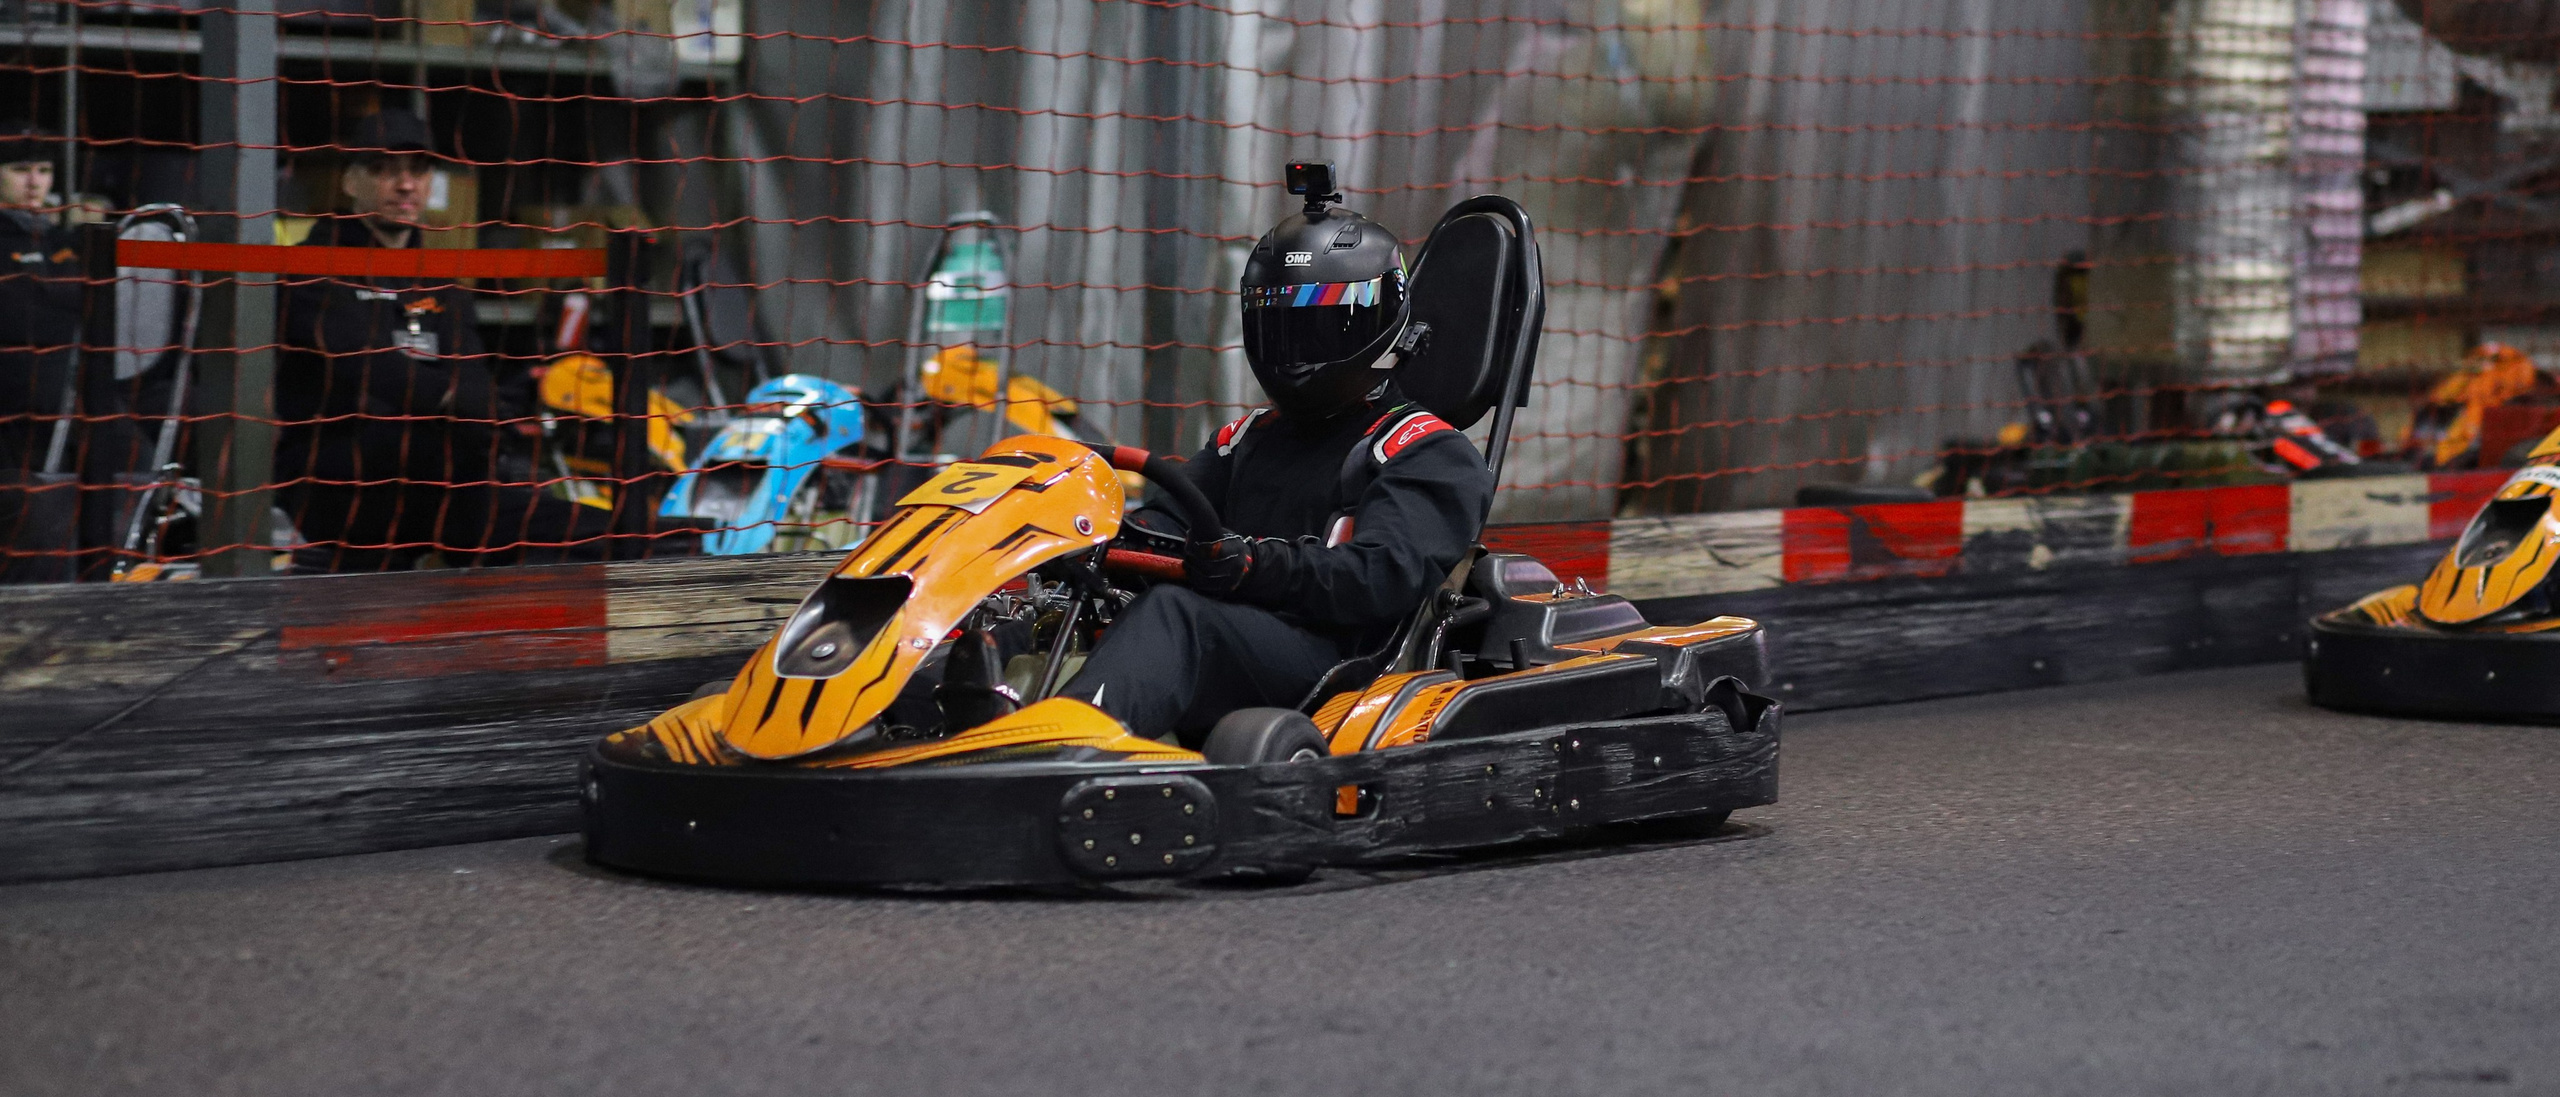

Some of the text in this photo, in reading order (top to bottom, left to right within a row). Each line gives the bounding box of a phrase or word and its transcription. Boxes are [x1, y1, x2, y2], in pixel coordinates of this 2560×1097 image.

[1285, 253, 1312, 264] OMP
[941, 471, 998, 494] 2
[1413, 708, 1436, 743] OWER
